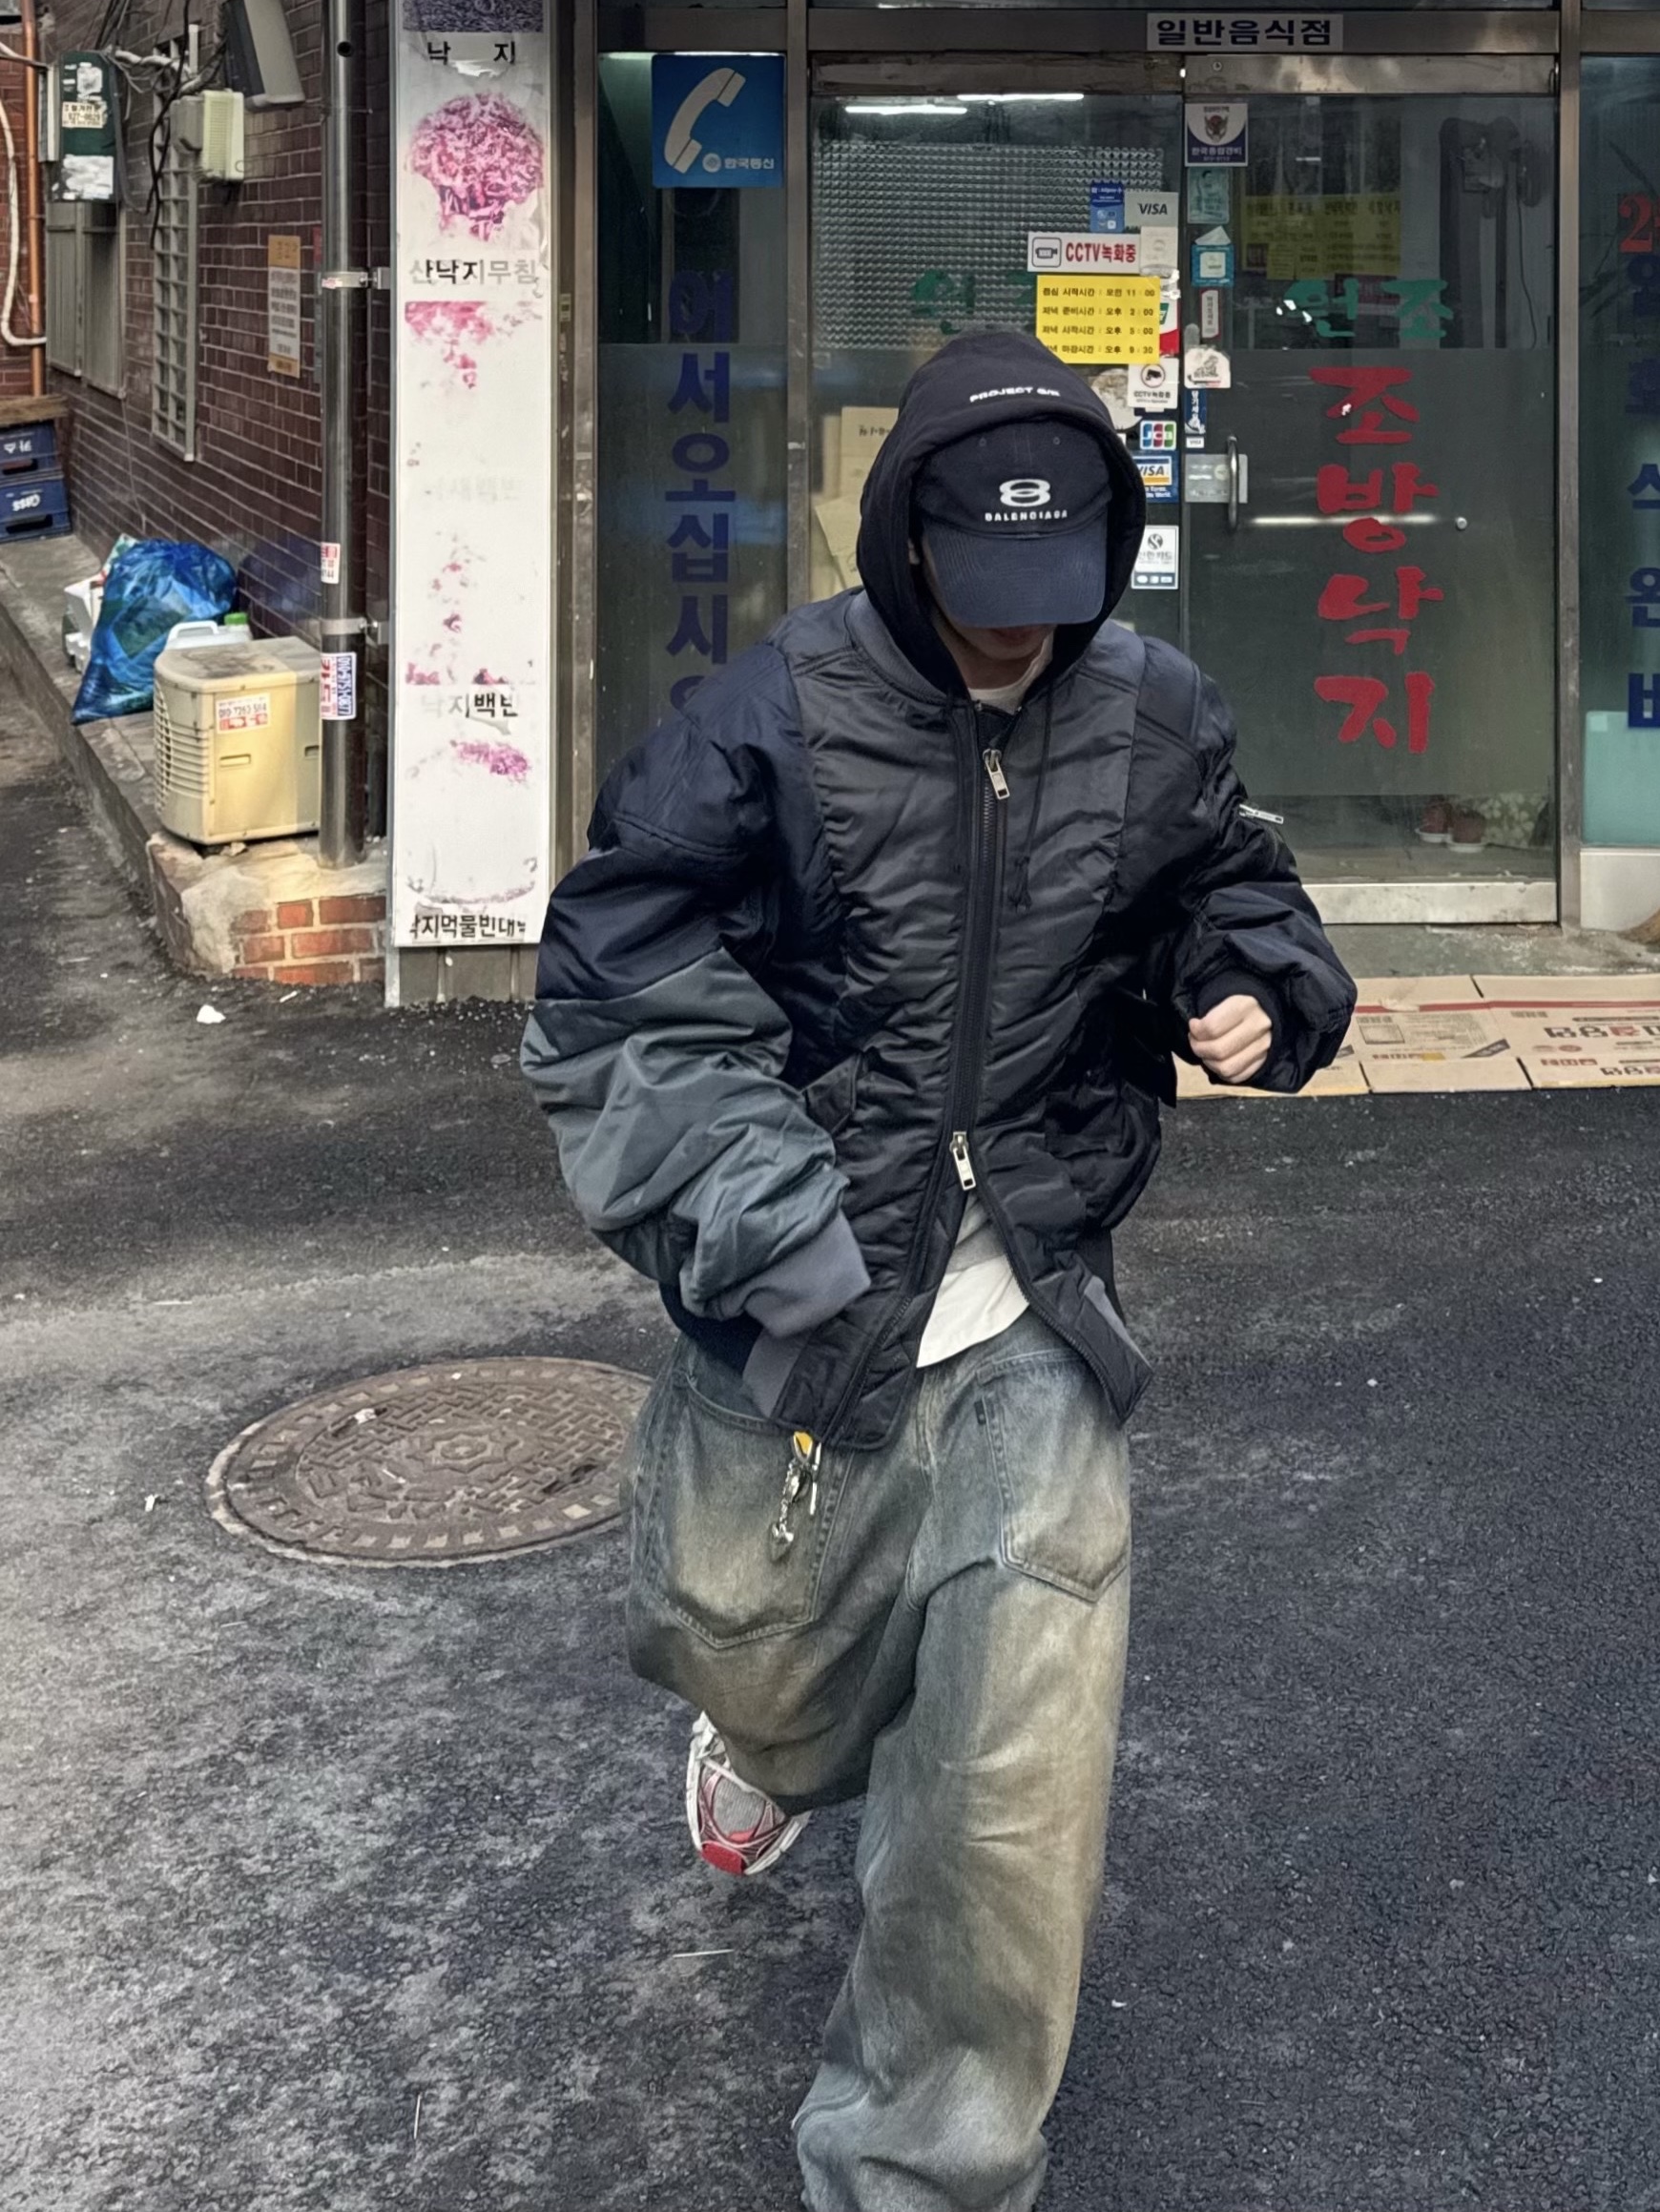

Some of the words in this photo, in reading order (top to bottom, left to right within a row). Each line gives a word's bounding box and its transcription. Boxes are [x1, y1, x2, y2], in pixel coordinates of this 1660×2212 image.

[1156, 19, 1332, 47] 일반음식점
[724, 157, 775, 170] 한국통신
[1137, 202, 1168, 216] VISA
[1065, 241, 1136, 263] CCTV녹화중
[409, 258, 538, 287] 산낙지무침
[1283, 278, 1454, 339] 원조
[969, 386, 1033, 403] PROJECT
[985, 509, 1068, 522] BALENCIAGA
[1308, 366, 1444, 754] 조방낙지
